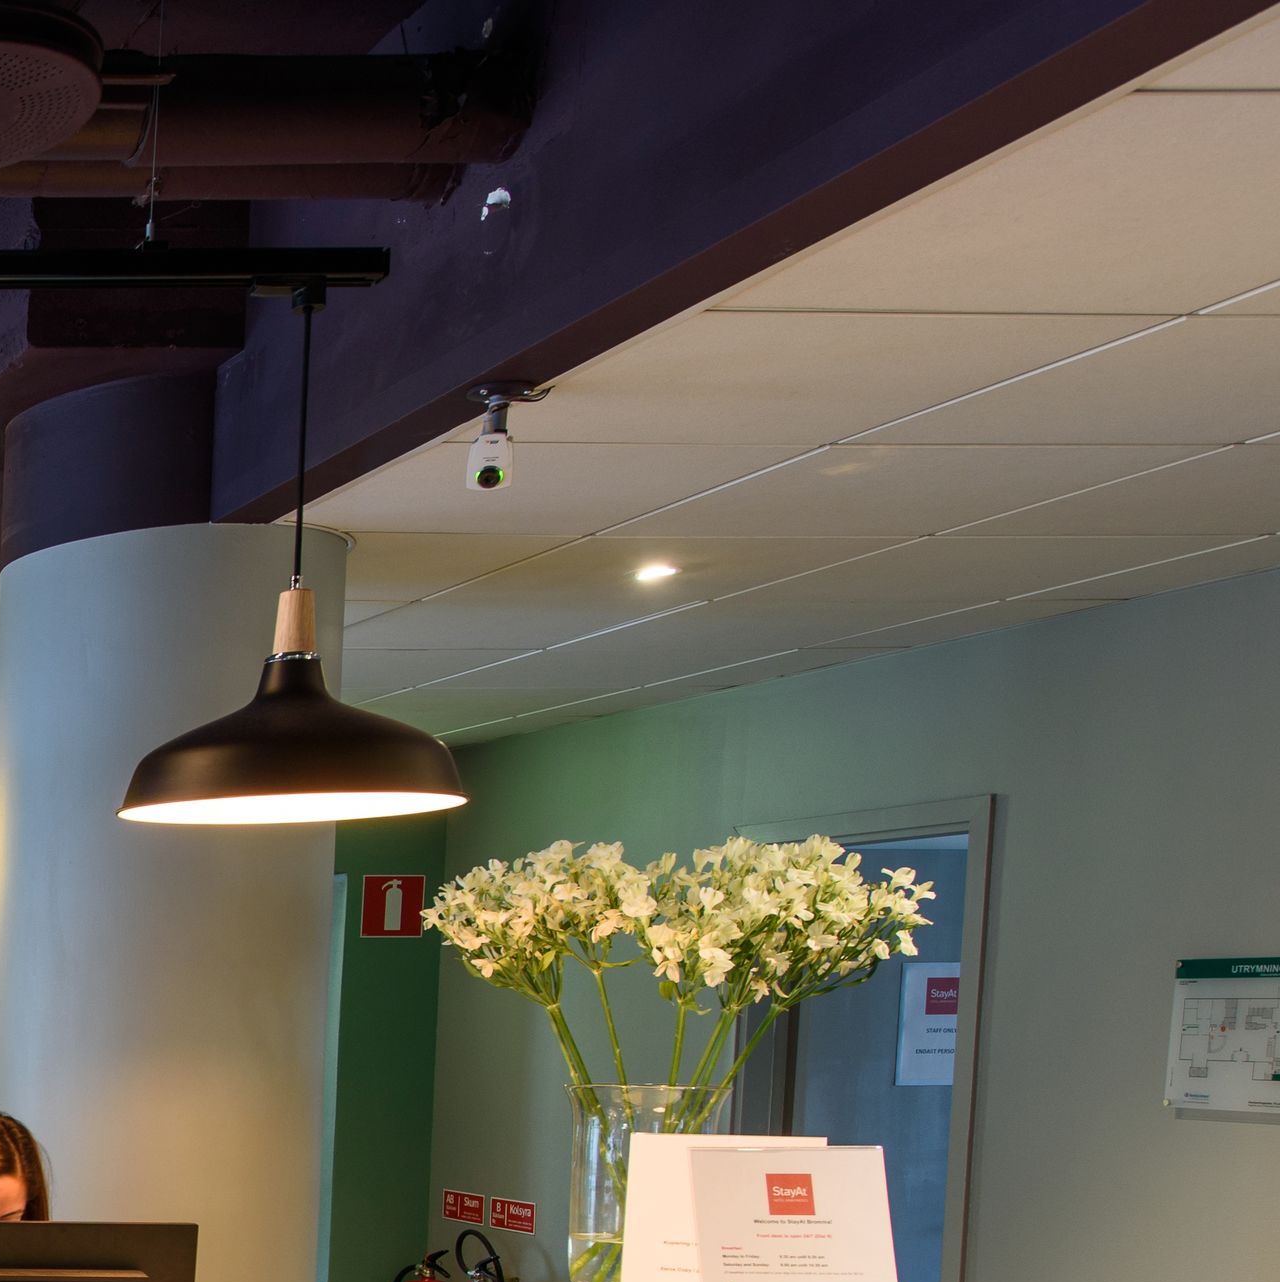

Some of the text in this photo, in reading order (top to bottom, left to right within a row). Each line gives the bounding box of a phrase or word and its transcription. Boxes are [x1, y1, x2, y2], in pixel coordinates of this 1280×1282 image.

[772, 1186, 808, 1198] StayAt
[463, 1197, 480, 1209] Skum
[496, 1202, 501, 1213] B
[509, 1204, 532, 1219] Kolsyra
